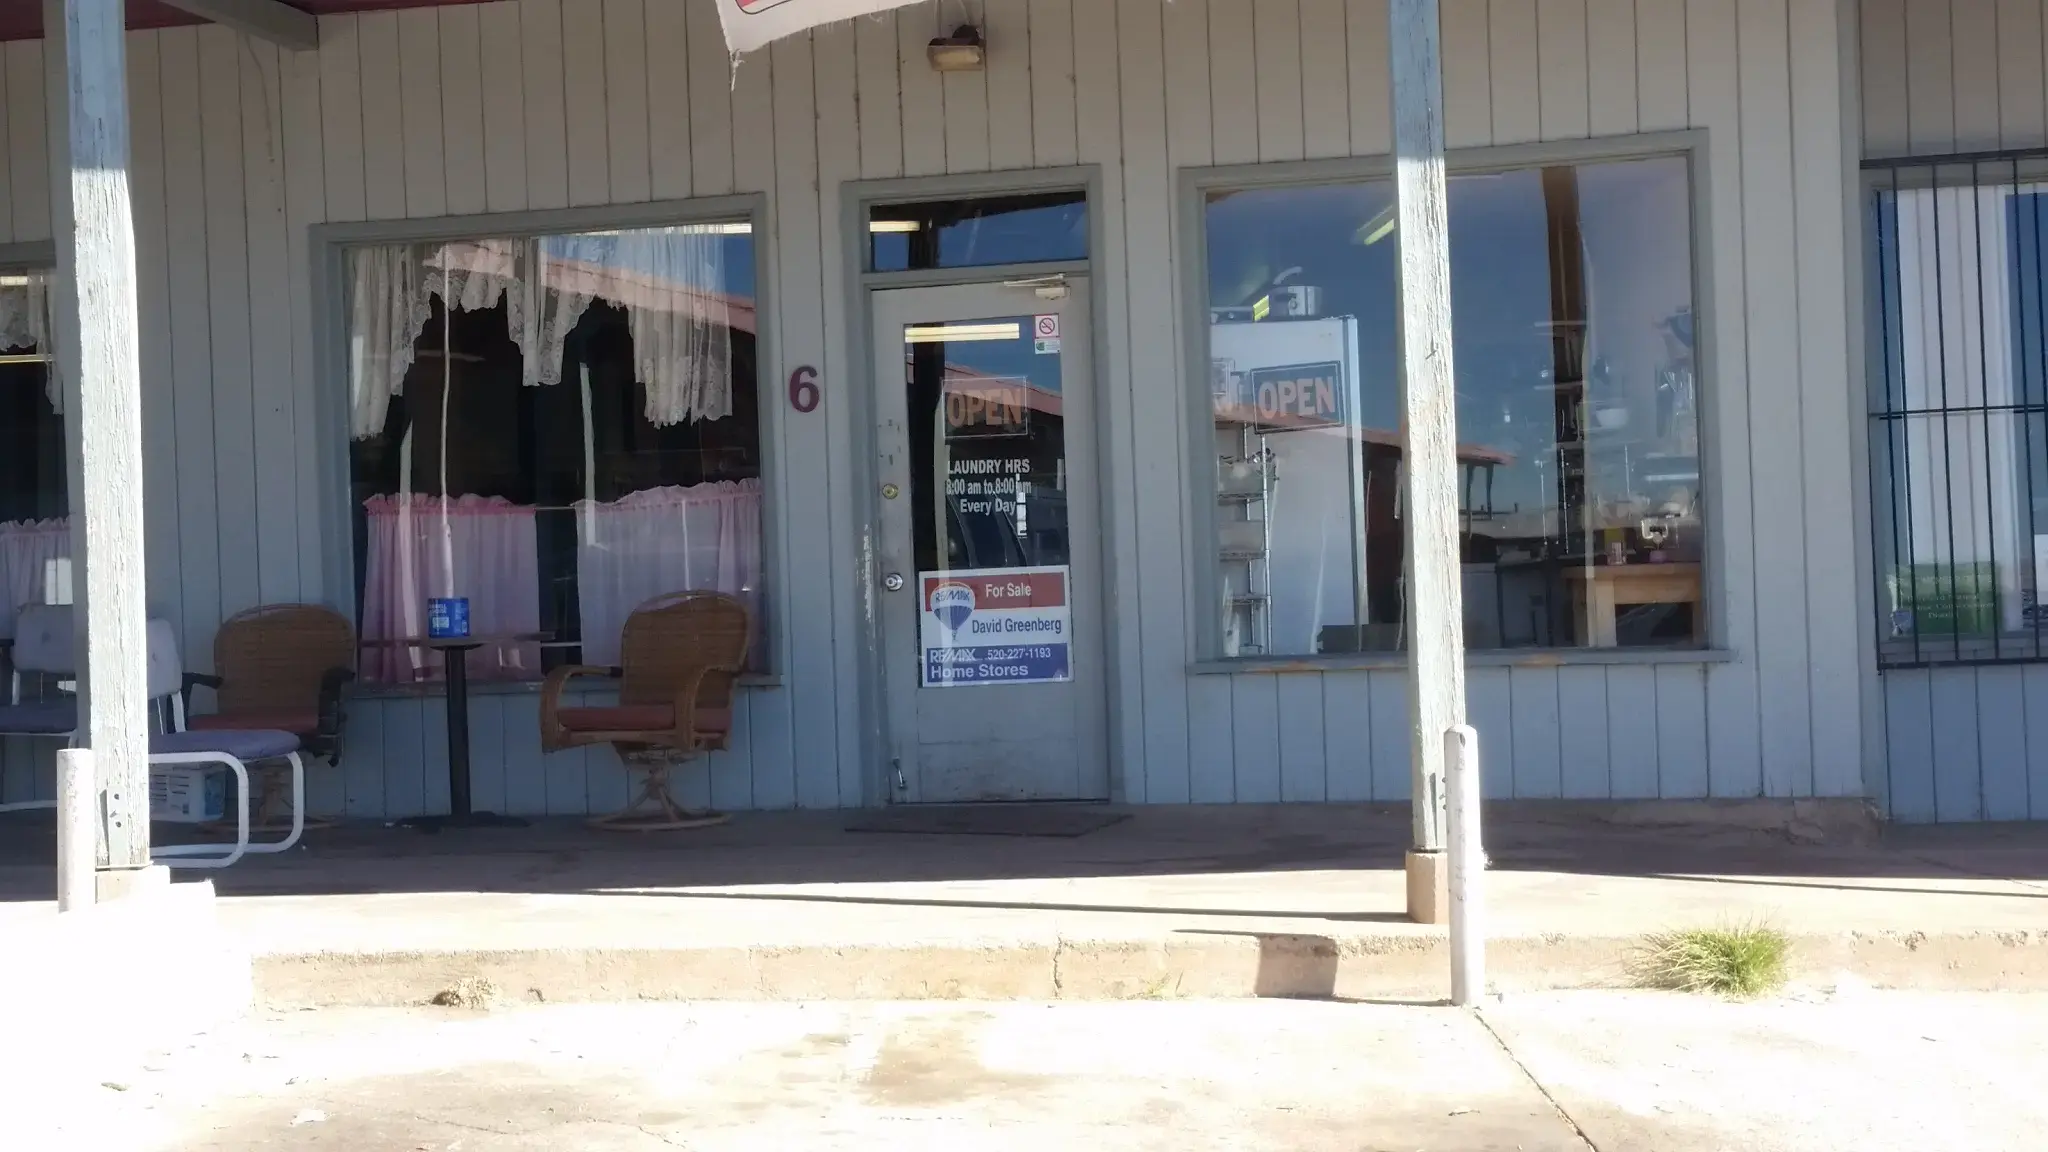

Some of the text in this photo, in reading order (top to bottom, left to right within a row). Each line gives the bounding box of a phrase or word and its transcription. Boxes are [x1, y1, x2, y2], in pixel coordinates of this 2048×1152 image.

[789, 365, 820, 413] 6
[1258, 376, 1336, 420] OPEN
[946, 388, 1022, 428] OPEN
[947, 458, 1031, 475] LAUNDRY HRS
[946, 478, 966, 495] 8:00
[967, 481, 982, 495] am
[983, 478, 993, 495] to
[995, 477, 1015, 495] 8:00
[960, 498, 1017, 516] Every Day
[985, 582, 1032, 598] For Sale
[972, 617, 1062, 635] David Greenberg
[986, 646, 1052, 660] 520-227-1193
[930, 663, 1029, 679] Home Stores
